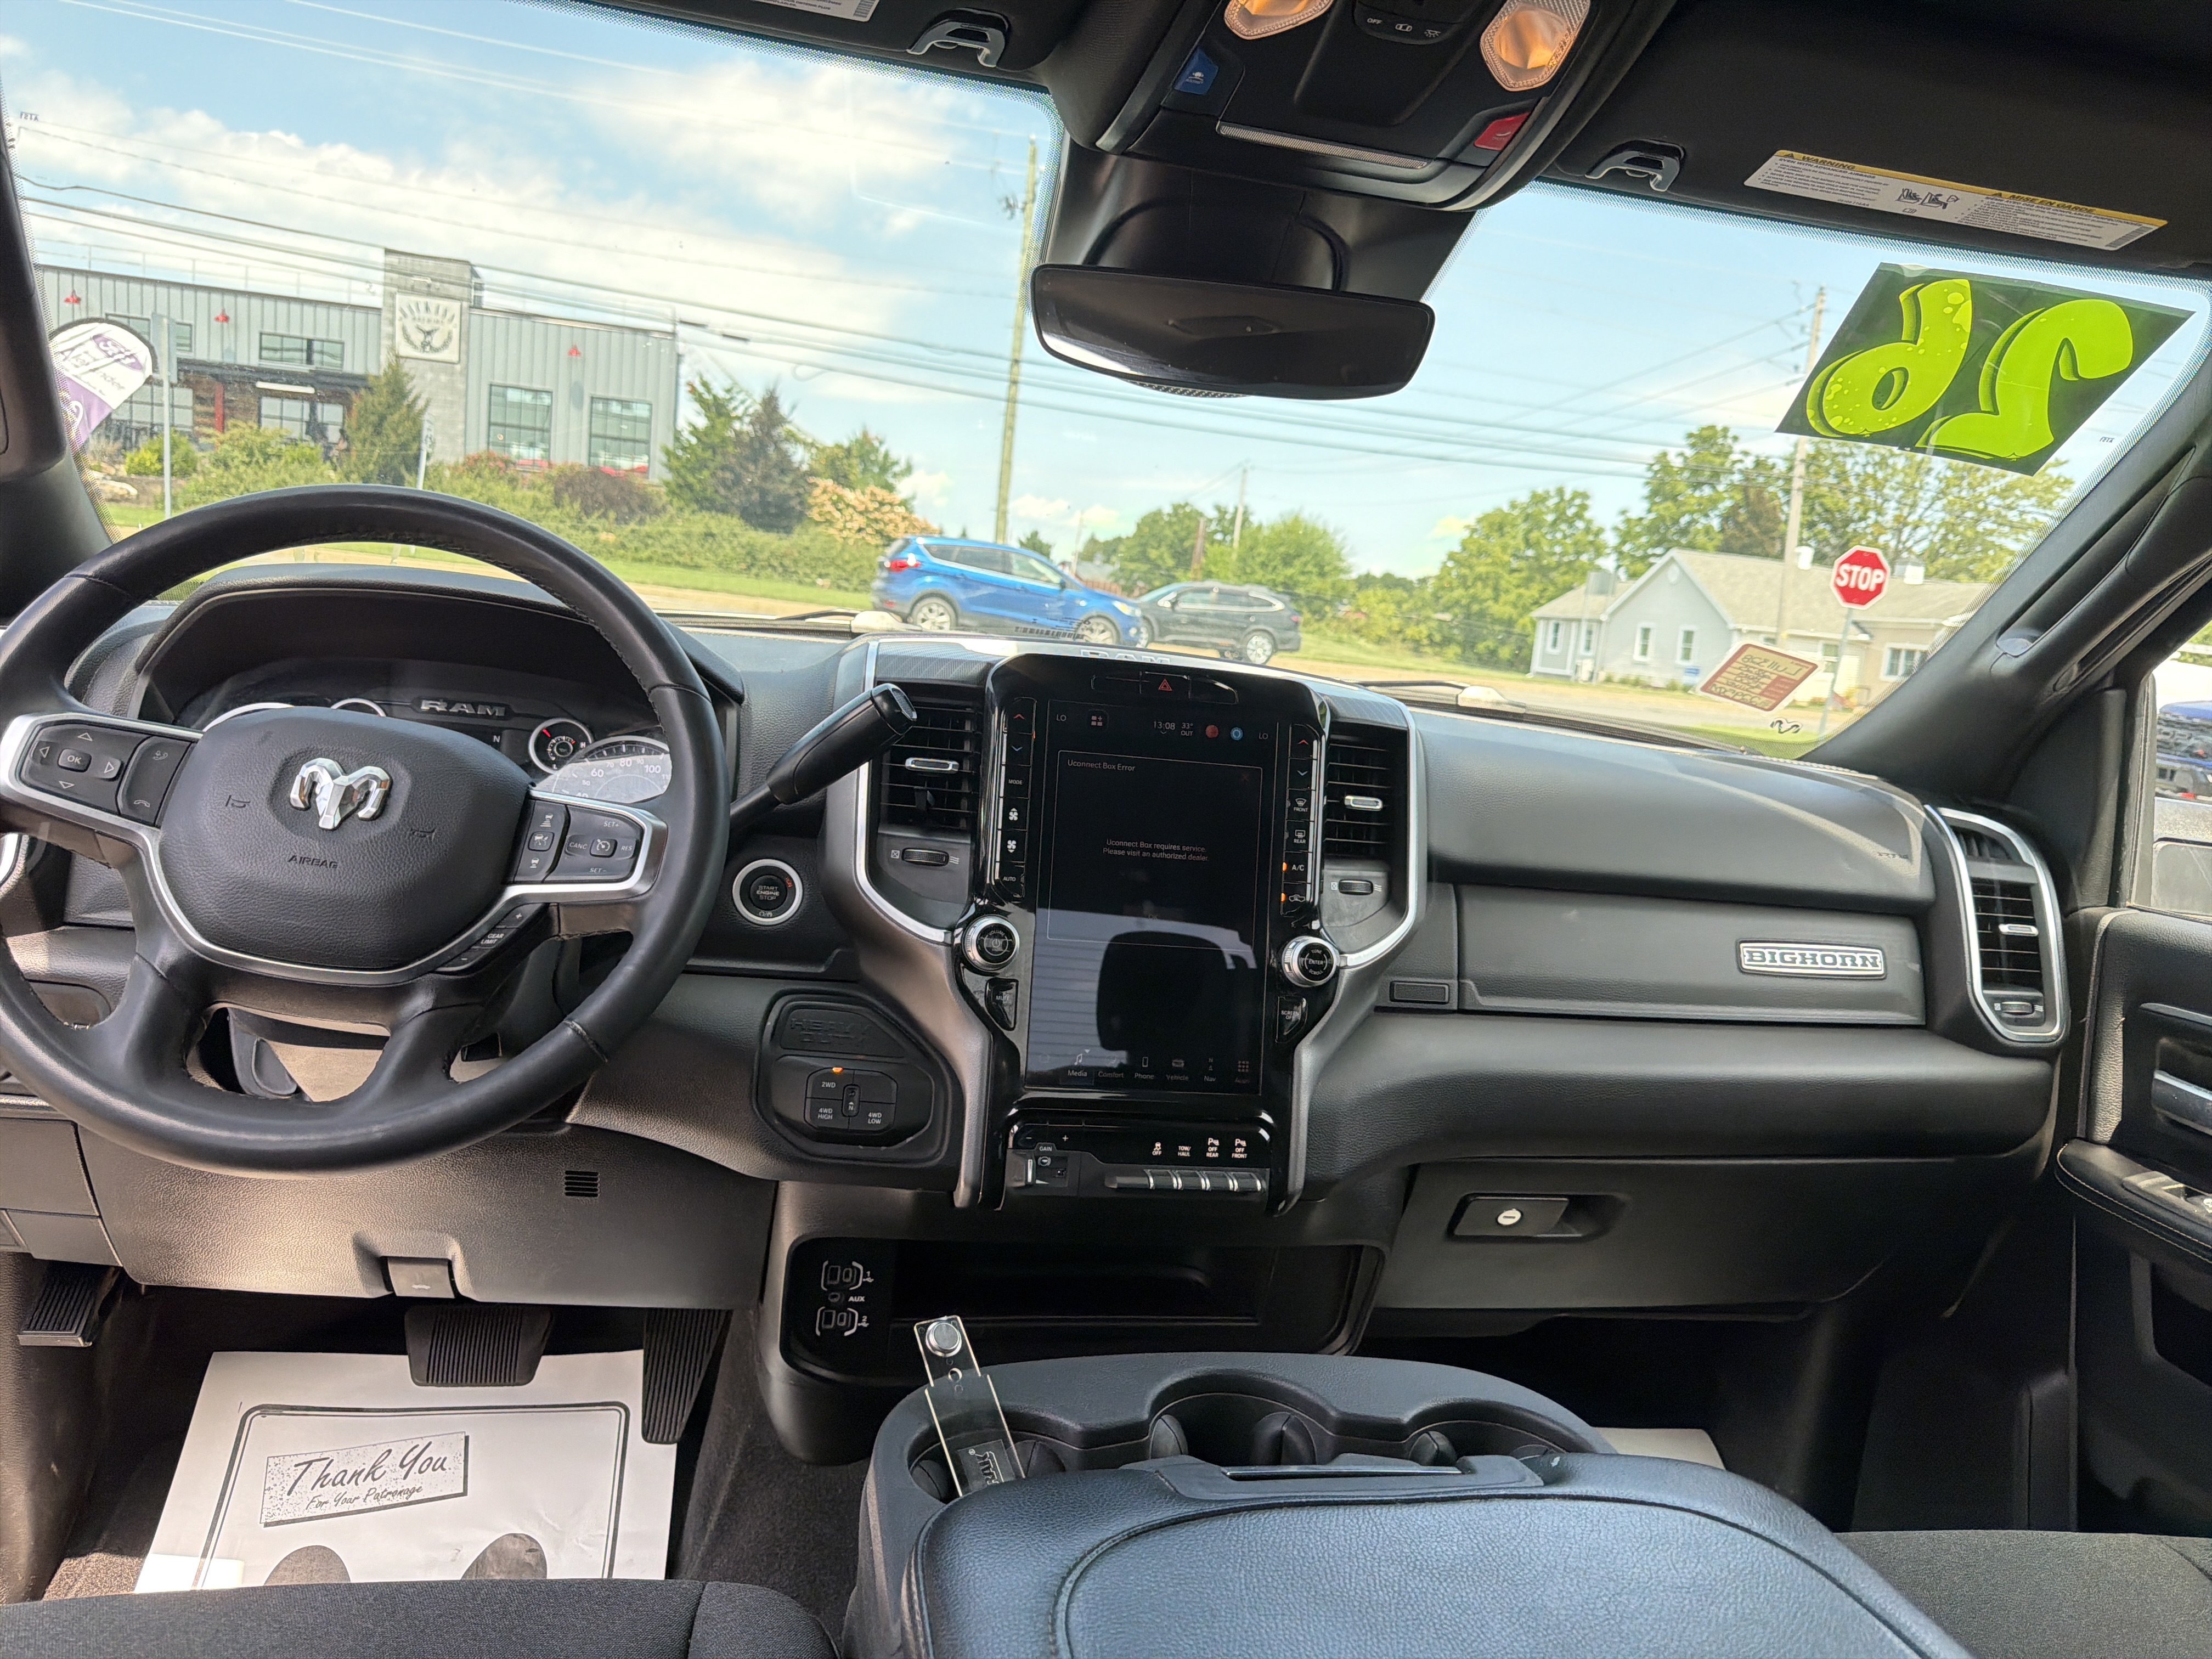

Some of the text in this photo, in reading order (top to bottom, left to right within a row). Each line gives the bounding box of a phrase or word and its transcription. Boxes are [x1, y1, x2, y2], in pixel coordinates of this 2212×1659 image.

[1802, 155, 1855, 170] WARNING
[1814, 164, 1848, 174] ADVANCED
[2009, 194, 2097, 214] MISE EN GARDE
[1836, 563, 1885, 592] STOP
[420, 699, 505, 716] RAM
[1153, 721, 1176, 731] 13:08
[67, 755, 82, 764] OK
[619, 759, 632, 767] 80
[1068, 759, 1136, 772] Uconnect Box Error
[591, 768, 604, 778] 60
[644, 765, 661, 774] 100
[569, 842, 588, 850] CANC
[1106, 838, 1138, 848] Uconnect
[1153, 843, 1181, 851] requires
[1103, 847, 1125, 856] Please
[1152, 851, 1187, 860] authorized
[287, 855, 338, 869] AIRBAG
[1745, 949, 1880, 968] BIGHORN
[1068, 1069, 1088, 1077] Media
[1098, 1070, 1125, 1079] Comfort
[286, 1441, 448, 1497] Thank You
[305, 1485, 423, 1510] For Your Patronage
